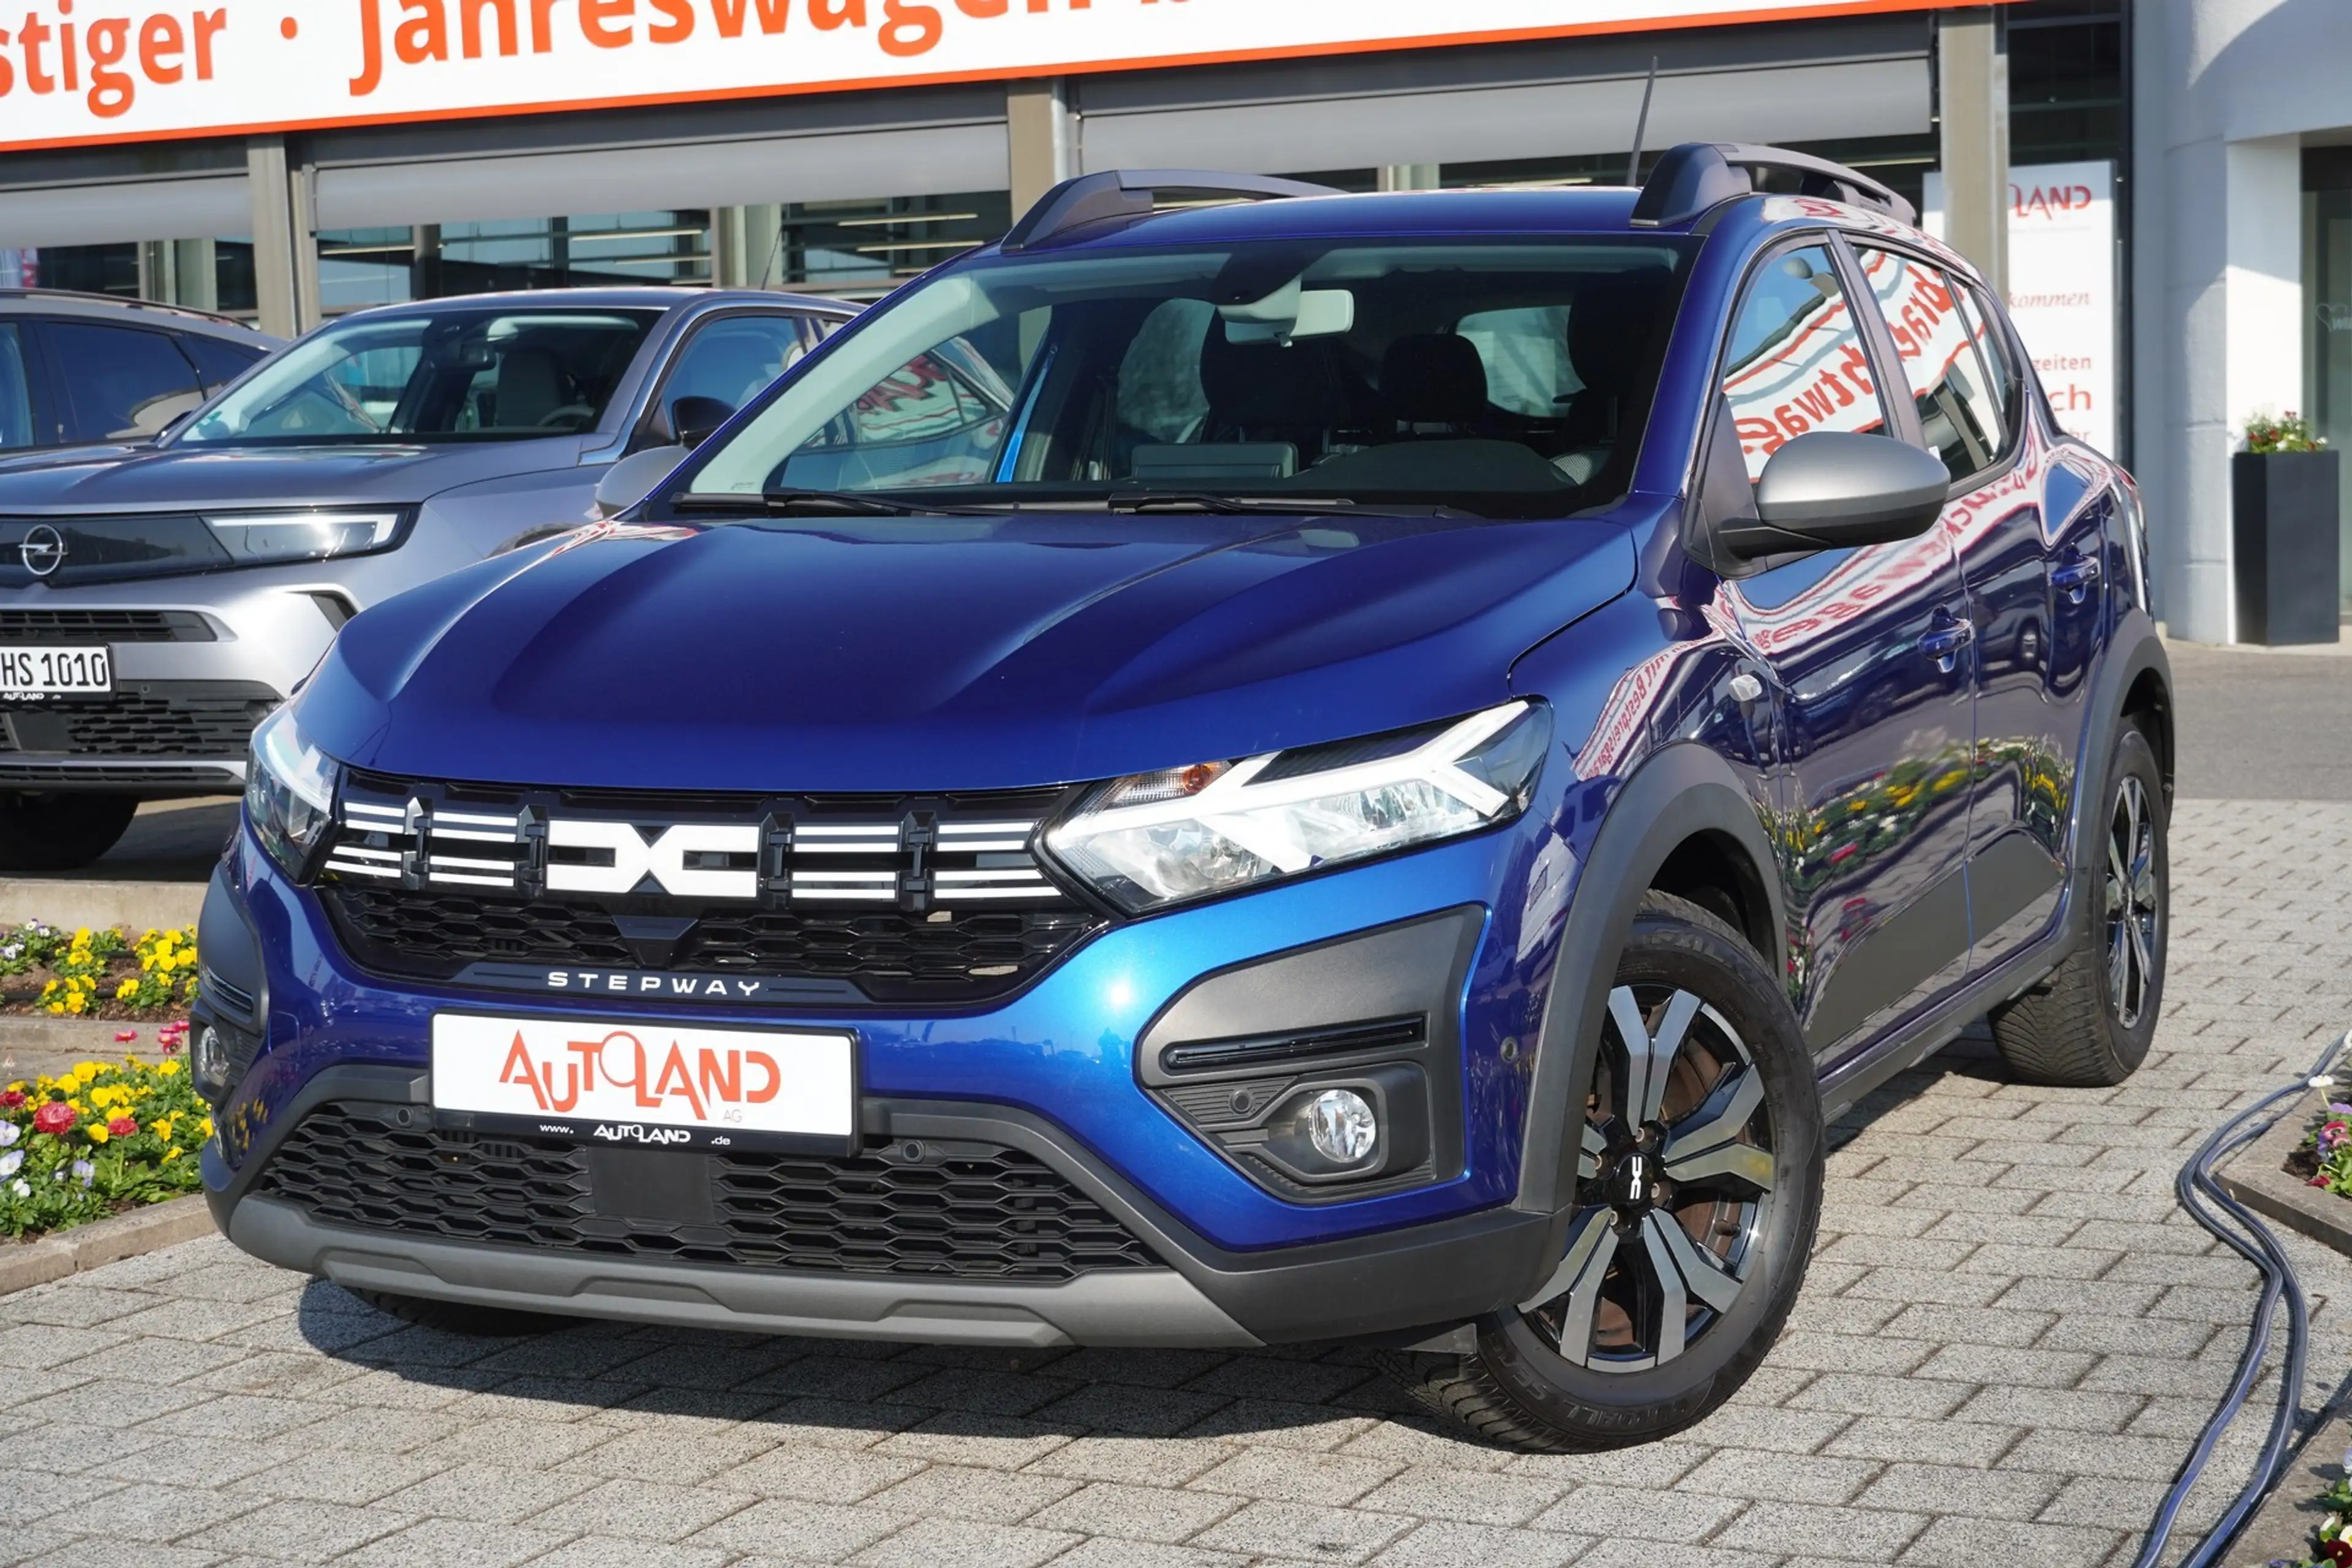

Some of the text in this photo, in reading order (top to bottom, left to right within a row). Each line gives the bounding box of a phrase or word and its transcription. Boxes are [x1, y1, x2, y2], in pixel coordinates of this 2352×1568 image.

[349, 0, 1088, 96] Jahres
[2009, 184, 2092, 221] LAND
[1, 652, 108, 687] HS 1010
[548, 971, 760, 996] STEPWAY
[499, 1029, 781, 1121] AUTOLAND
[723, 1109, 743, 1123] AG
[540, 1125, 731, 1145] www. AUTOLAND .de
